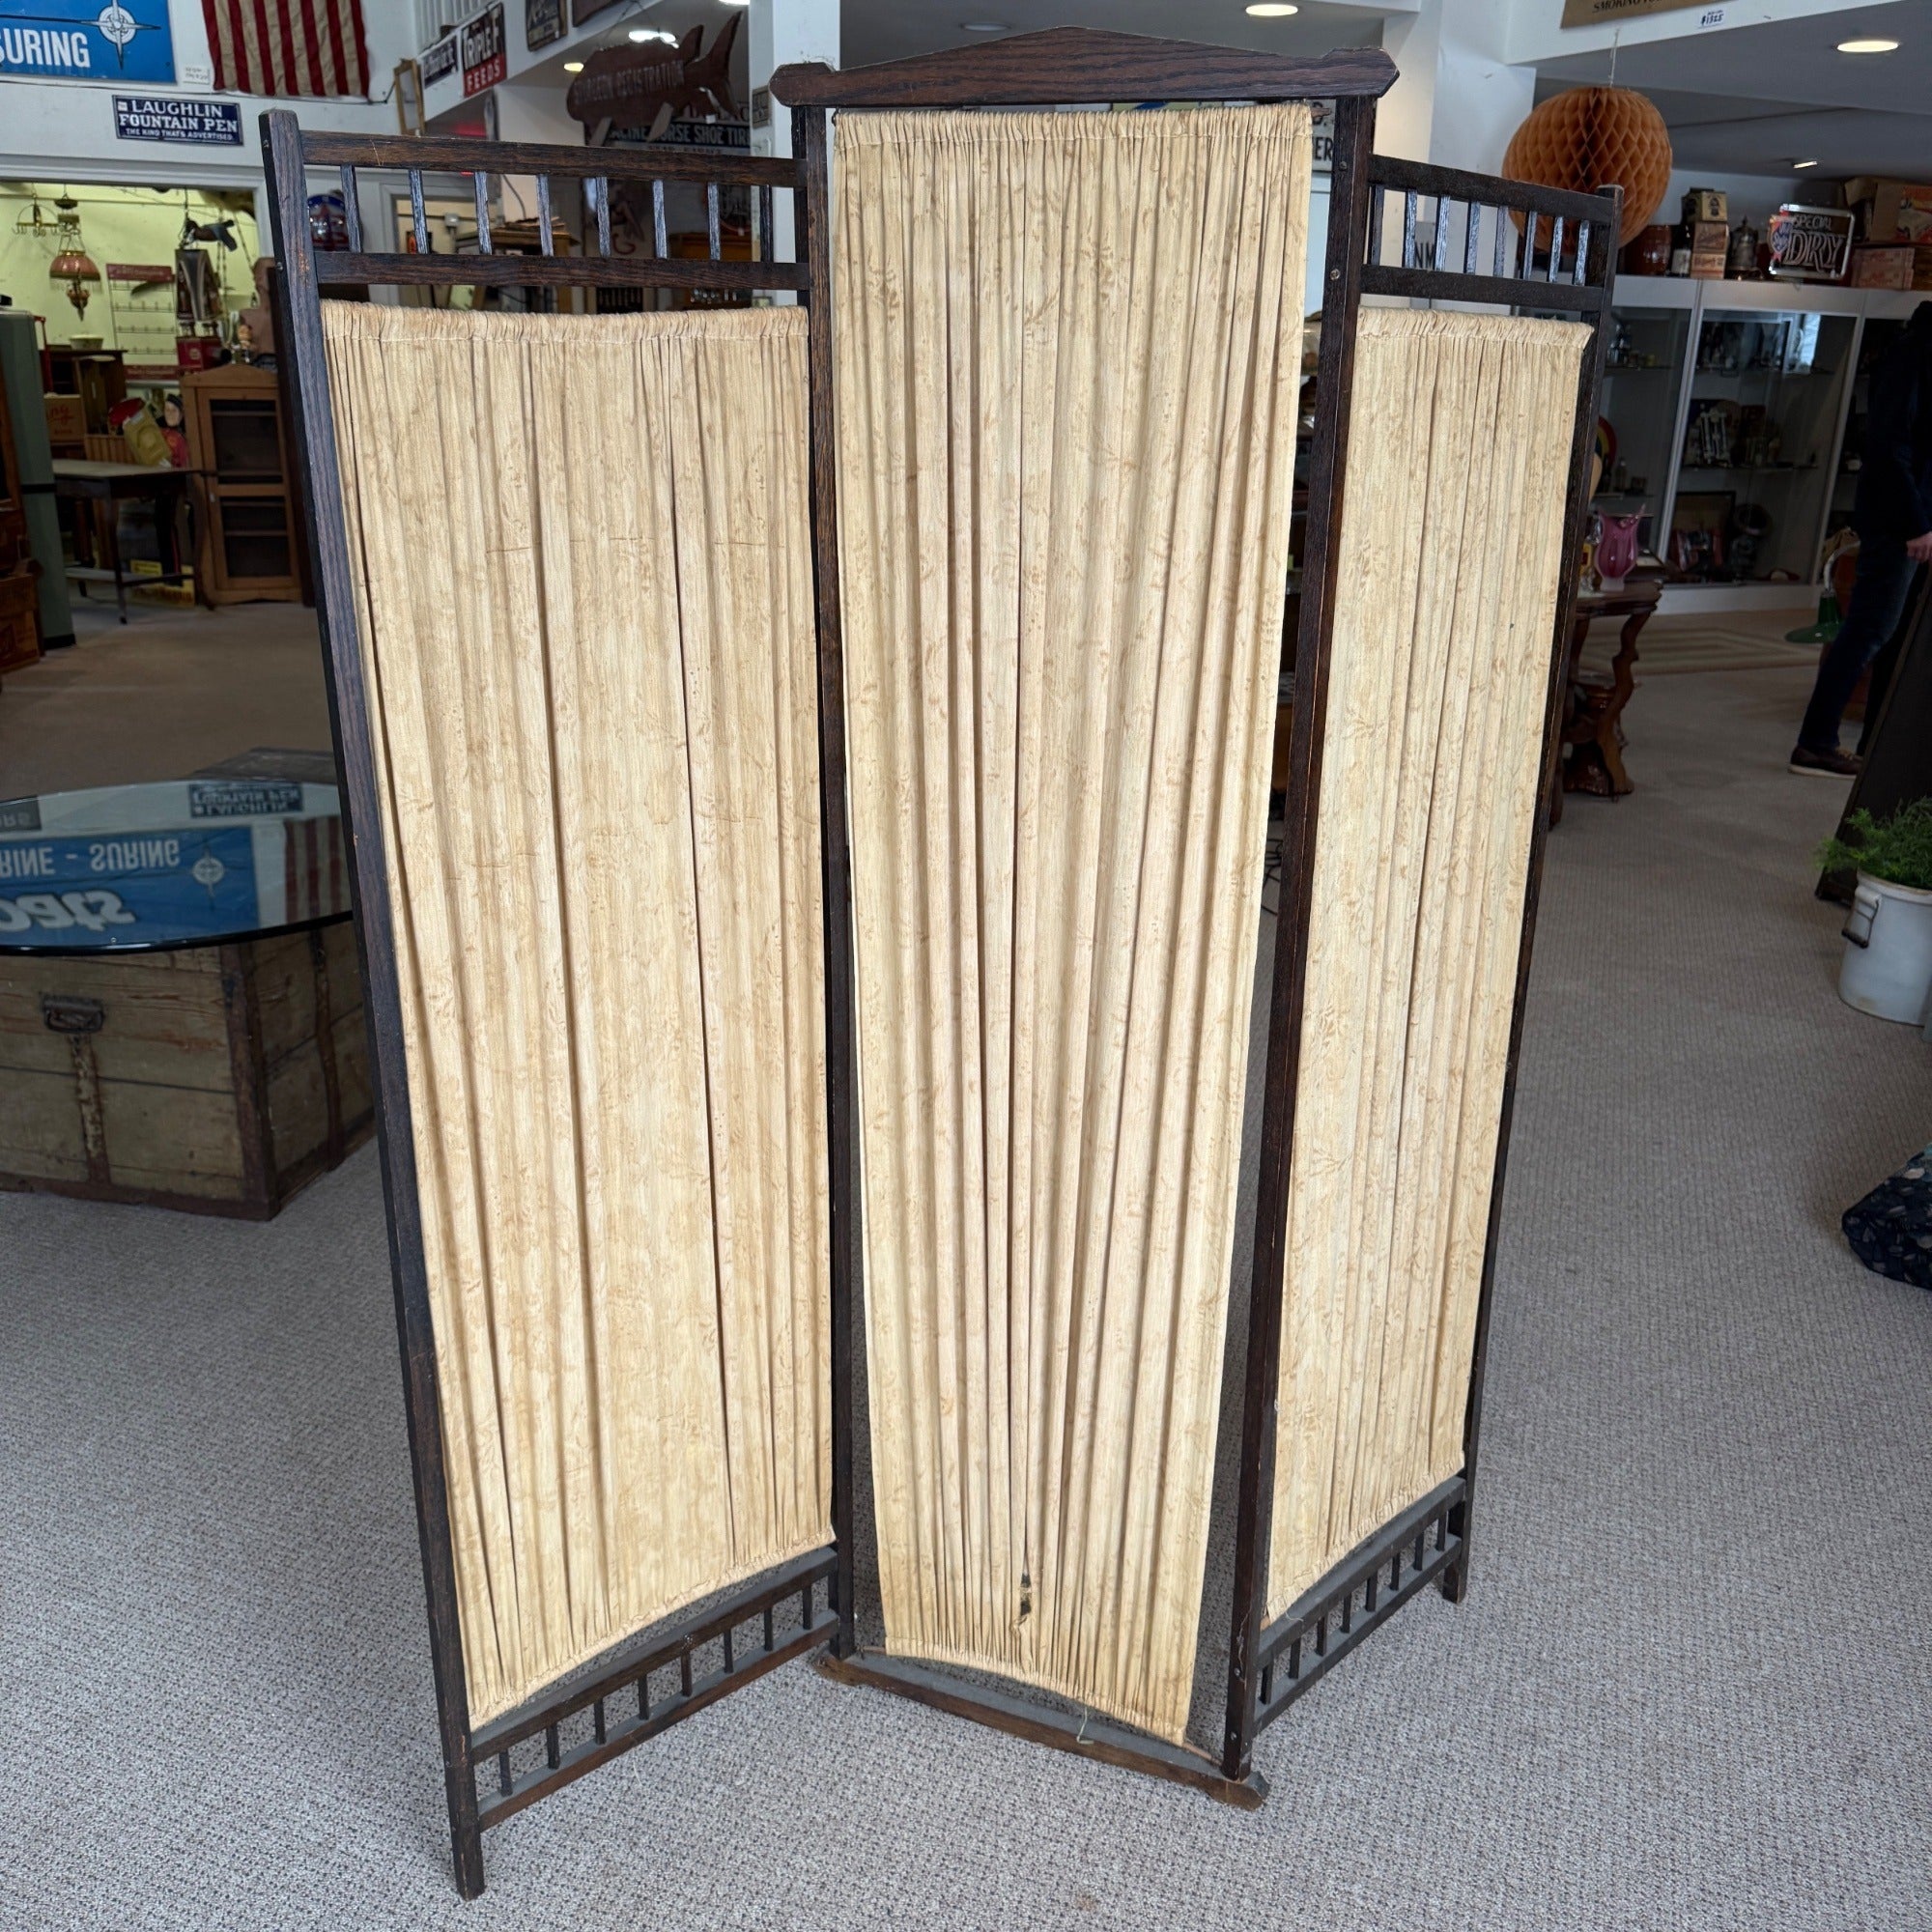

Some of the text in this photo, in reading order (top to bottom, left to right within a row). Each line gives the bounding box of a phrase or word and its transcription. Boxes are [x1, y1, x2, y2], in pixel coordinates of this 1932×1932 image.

[0, 27, 91, 68] URING
[467, 58, 500, 93] FEEDS
[131, 99, 223, 118] LAUGHLIN
[118, 113, 239, 133] FOUNTAIN PEN
[694, 125, 724, 145] SHOE
[1794, 214, 1833, 231] SPECIAL
[1783, 228, 1848, 272] DRY
